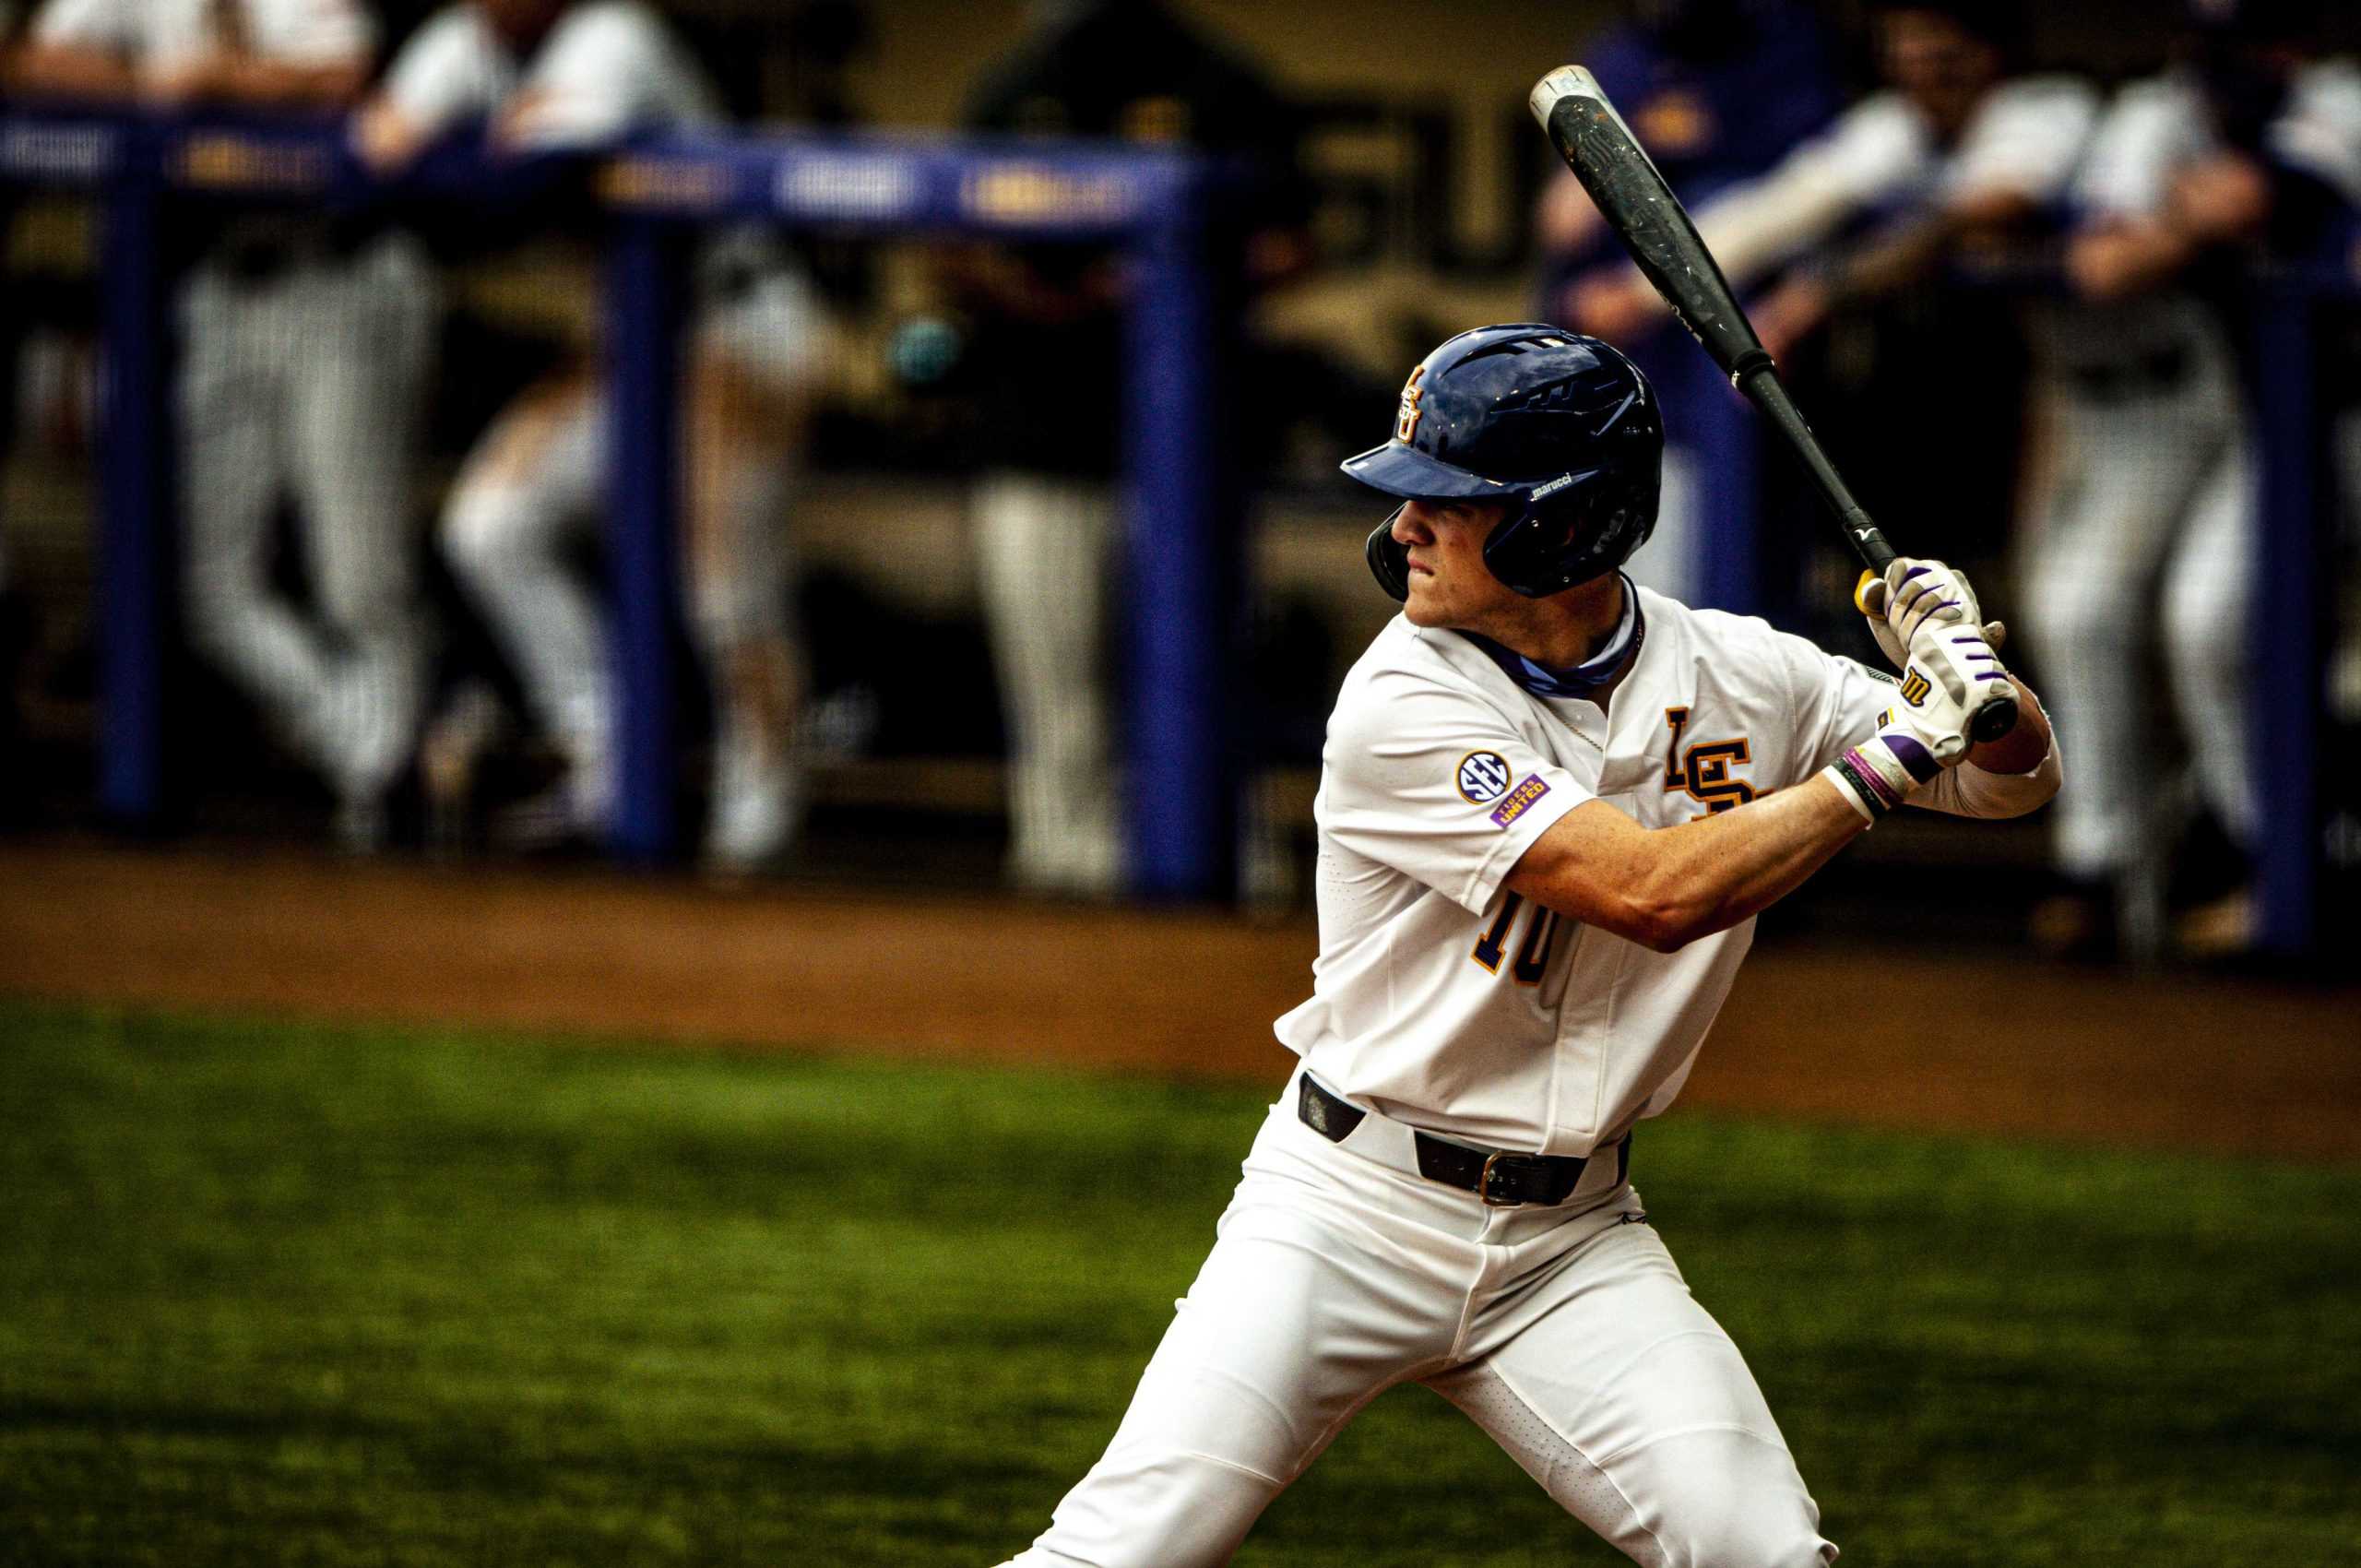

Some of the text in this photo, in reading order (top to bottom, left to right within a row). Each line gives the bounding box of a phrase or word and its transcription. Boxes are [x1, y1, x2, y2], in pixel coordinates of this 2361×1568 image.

[1532, 472, 1572, 498] marucci
[1460, 754, 1507, 801] SEC
[1664, 706, 1775, 822] LS
[1500, 782, 1545, 824] UNITED
